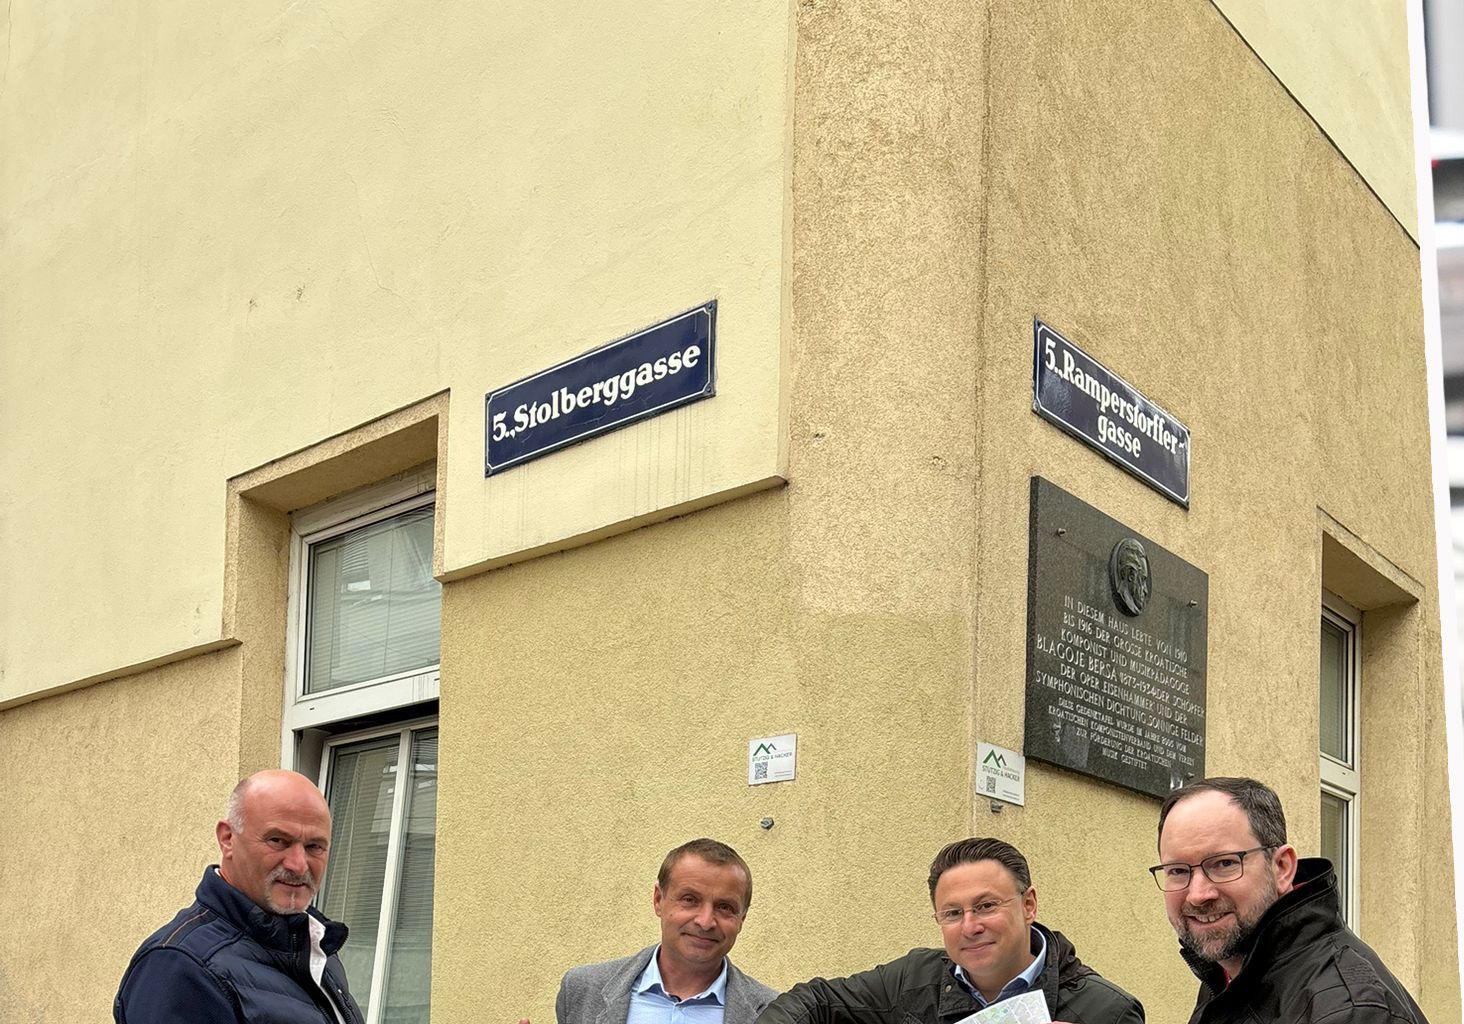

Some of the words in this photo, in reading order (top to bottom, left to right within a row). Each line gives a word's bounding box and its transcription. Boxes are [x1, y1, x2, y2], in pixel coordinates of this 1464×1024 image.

[1098, 415, 1142, 458] gasse
[1061, 628, 1107, 658] KOMPONIST
[1110, 649, 1127, 667] UND
[1063, 612, 1075, 627] BIS
[1078, 618, 1093, 634] 1916
[1096, 627, 1111, 644] DER
[1113, 635, 1142, 658] GROSSE
[1064, 595, 1074, 610] IN
[1077, 601, 1104, 624] DIESEM
[1108, 616, 1129, 635] HAUS
[1131, 627, 1152, 647] LEBTE
[1156, 639, 1172, 658] VON
[1037, 633, 1085, 668] BLAGOJE
[1088, 656, 1118, 682] BERSA
[1036, 670, 1105, 708] SYMPHONISCHEN
[1106, 698, 1147, 724] DICHTUNG
[1060, 663, 1076, 681] DER
[1080, 671, 1100, 691] OPER
[1156, 702, 1173, 719] UND
[1174, 710, 1188, 726] DER
